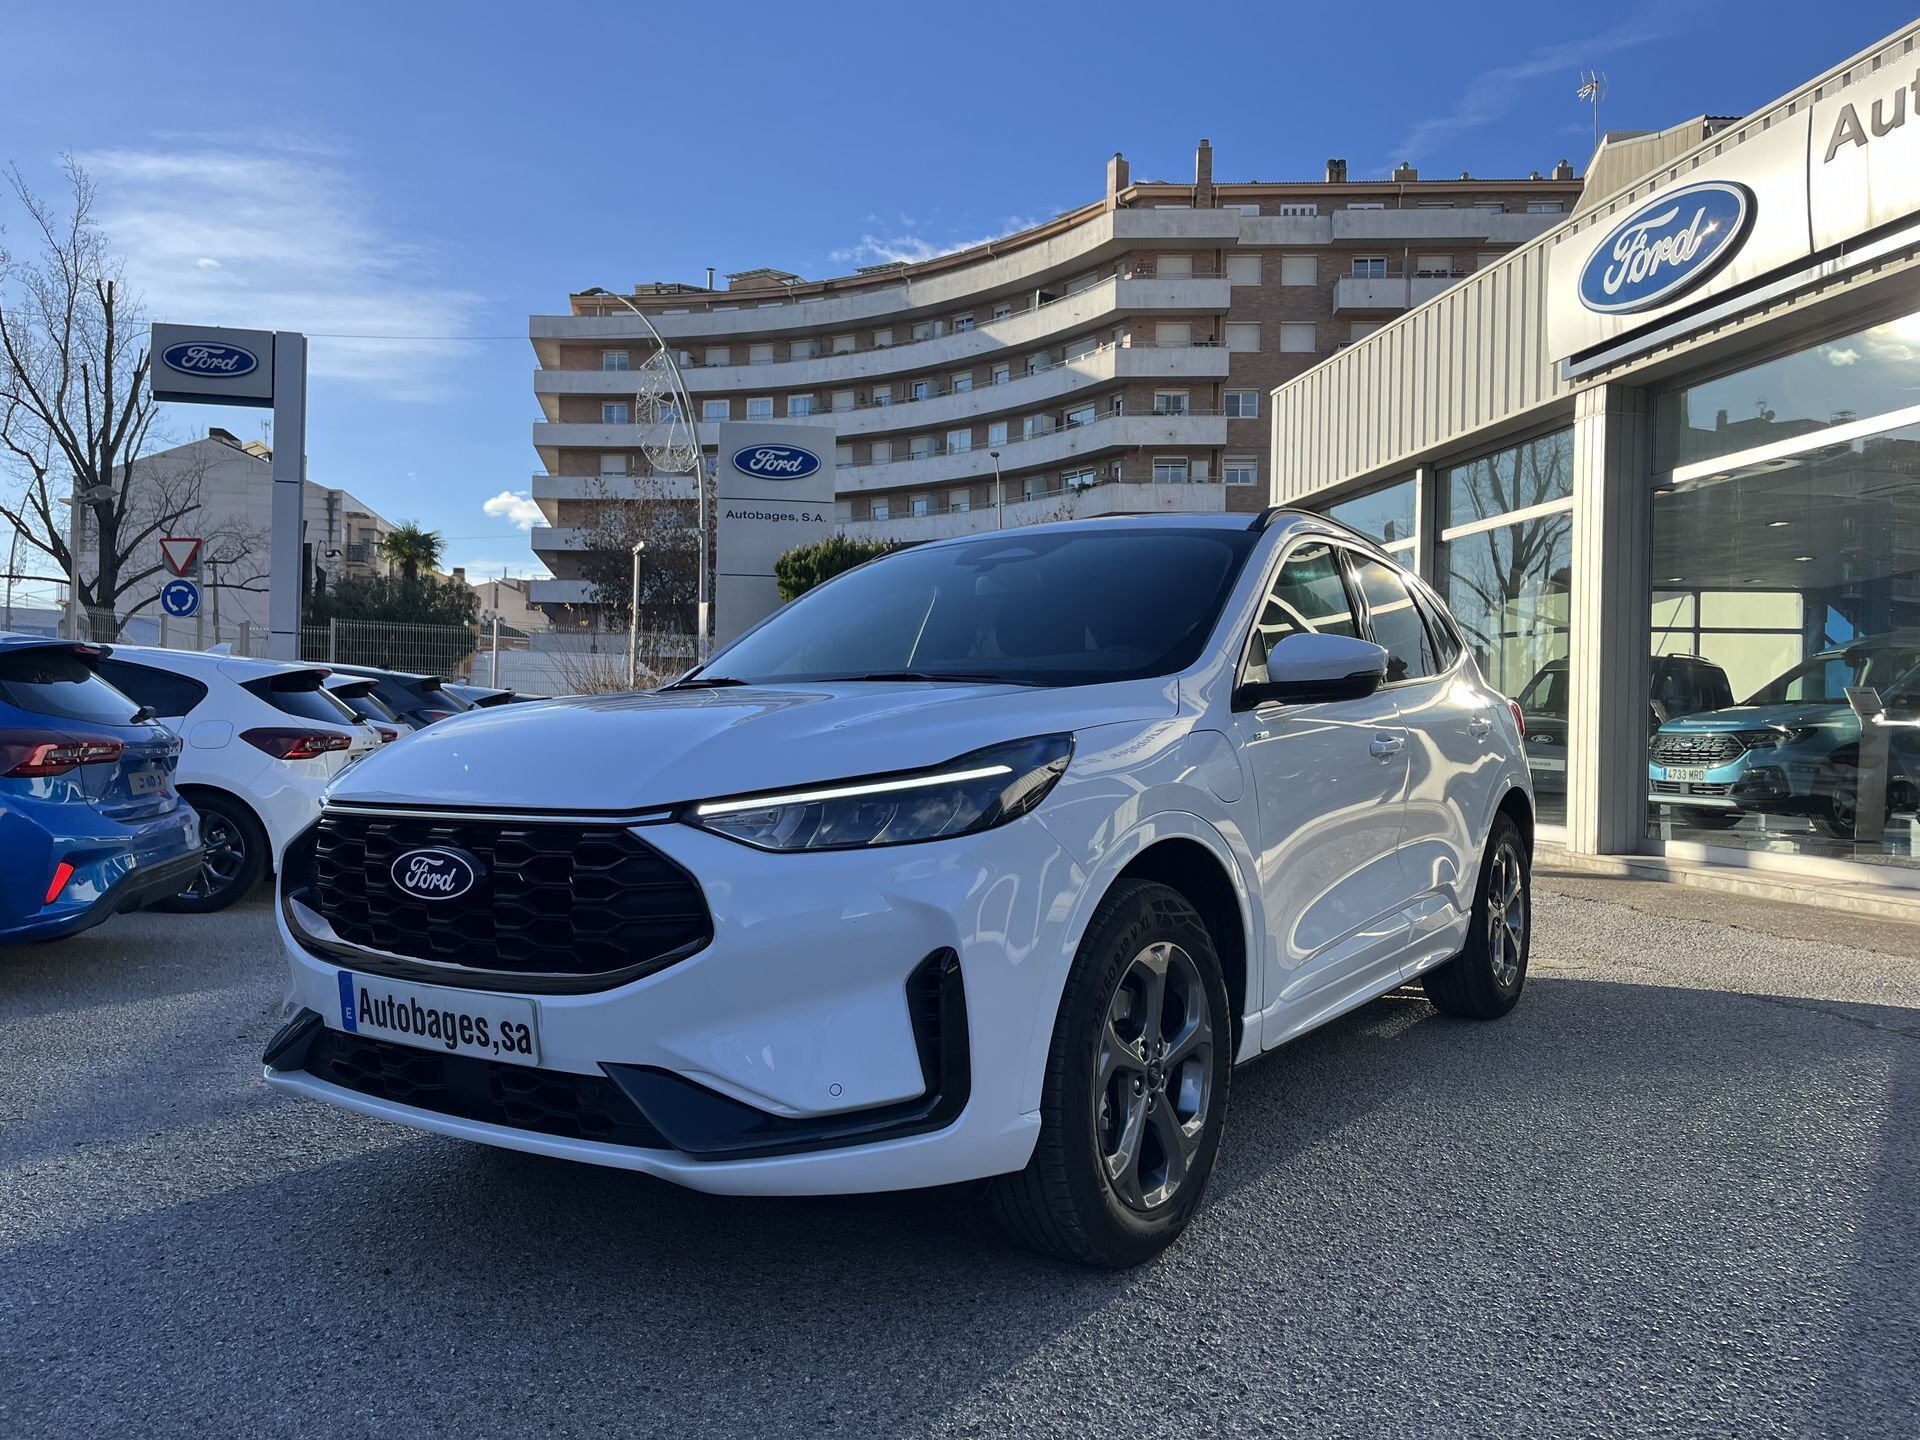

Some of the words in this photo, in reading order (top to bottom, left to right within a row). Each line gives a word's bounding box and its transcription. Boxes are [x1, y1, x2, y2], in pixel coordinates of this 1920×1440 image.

[1603, 205, 1706, 295] Ford
[181, 346, 240, 370] Ford
[750, 449, 803, 472] Ford
[725, 510, 799, 523] Autobages,
[801, 512, 827, 523] S.A.
[1668, 769, 1686, 780] 4733
[405, 855, 457, 893] Ford
[345, 1007, 353, 1020] E
[358, 987, 533, 1056] Autobages,sa
